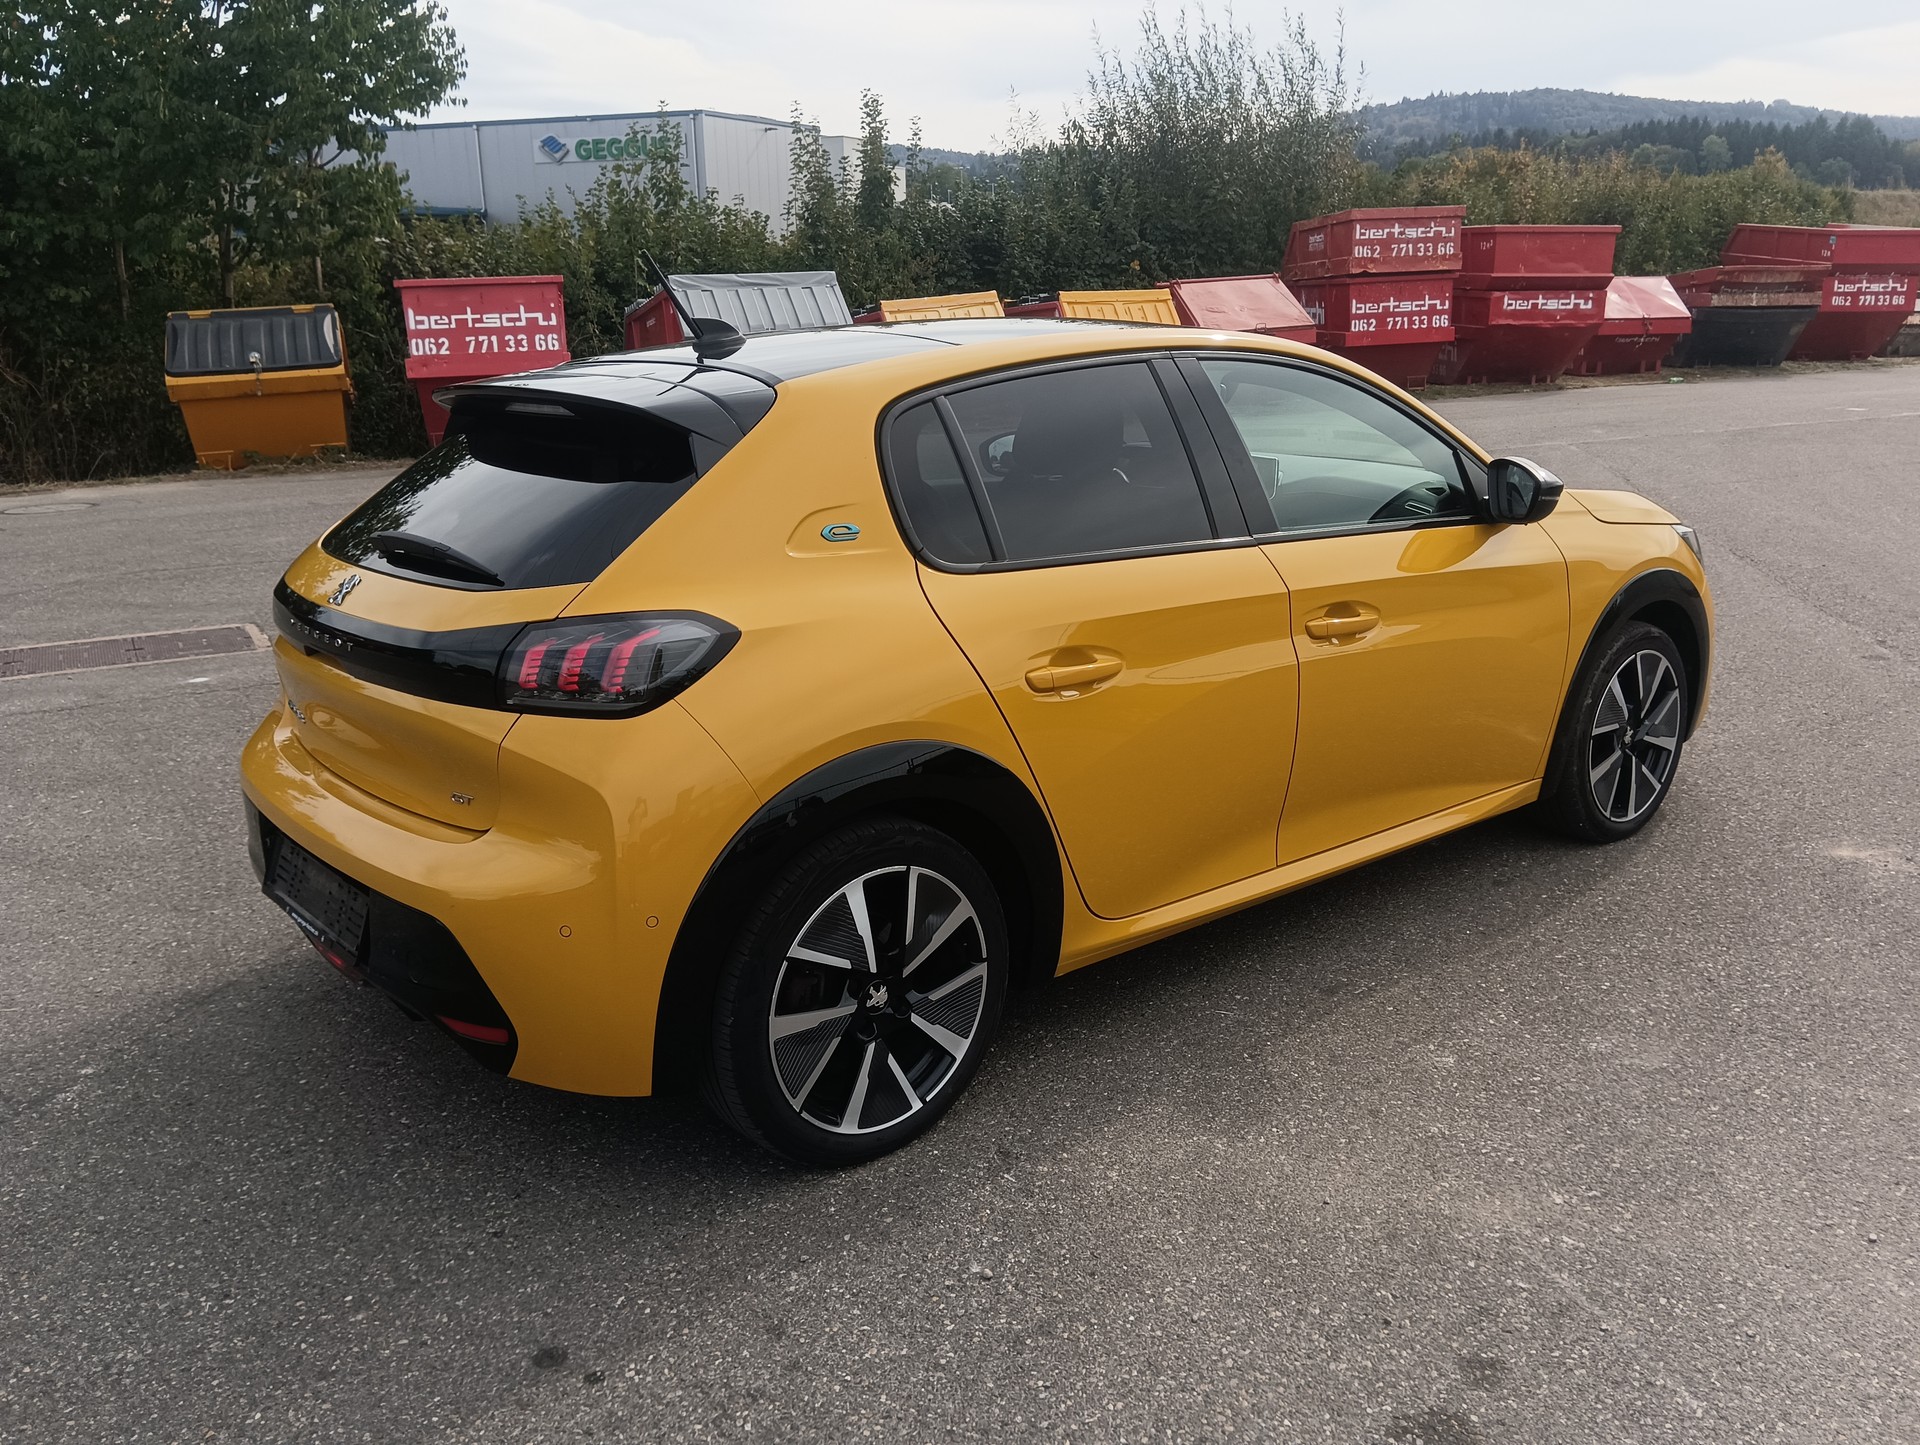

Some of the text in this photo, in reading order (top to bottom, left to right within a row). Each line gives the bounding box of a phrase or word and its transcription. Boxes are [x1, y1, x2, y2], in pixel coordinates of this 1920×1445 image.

[1355, 220, 1455, 239] bertschi
[1354, 242, 1455, 258] 062 771 33 66
[1833, 279, 1908, 292] bertschi
[1351, 293, 1450, 314] bertschi
[1503, 293, 1594, 310] bertschi
[1832, 295, 1905, 306] 062 771 33 66
[408, 302, 558, 330] bertschi
[1351, 314, 1449, 332] 062 771 33 66
[411, 333, 560, 356] 062 771 33 66
[451, 791, 474, 806] GT
